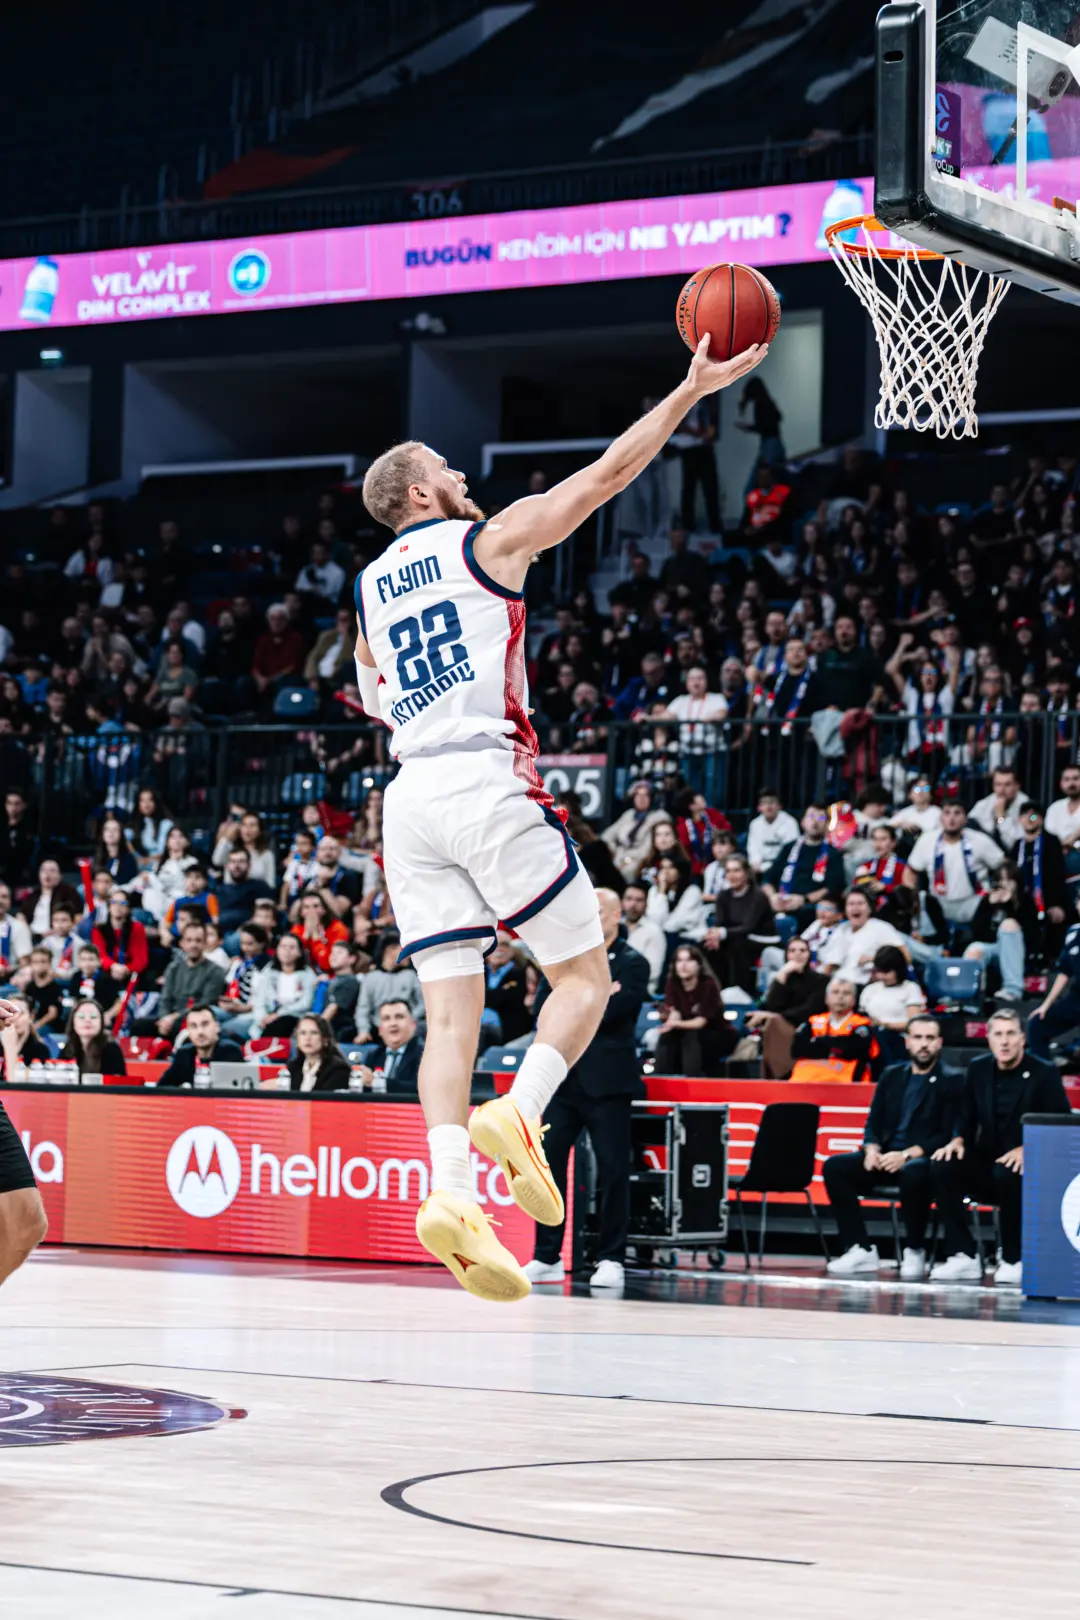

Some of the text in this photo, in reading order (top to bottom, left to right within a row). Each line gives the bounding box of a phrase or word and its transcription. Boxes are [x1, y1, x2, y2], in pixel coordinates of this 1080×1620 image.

[410, 187, 464, 218] 306
[405, 237, 493, 268] BUGÜN
[629, 225, 668, 252] NE
[117, 289, 211, 317] COMPLEX
[376, 554, 443, 604] FLYNN
[388, 599, 470, 691] 22
[250, 1143, 516, 1207] hellomto
